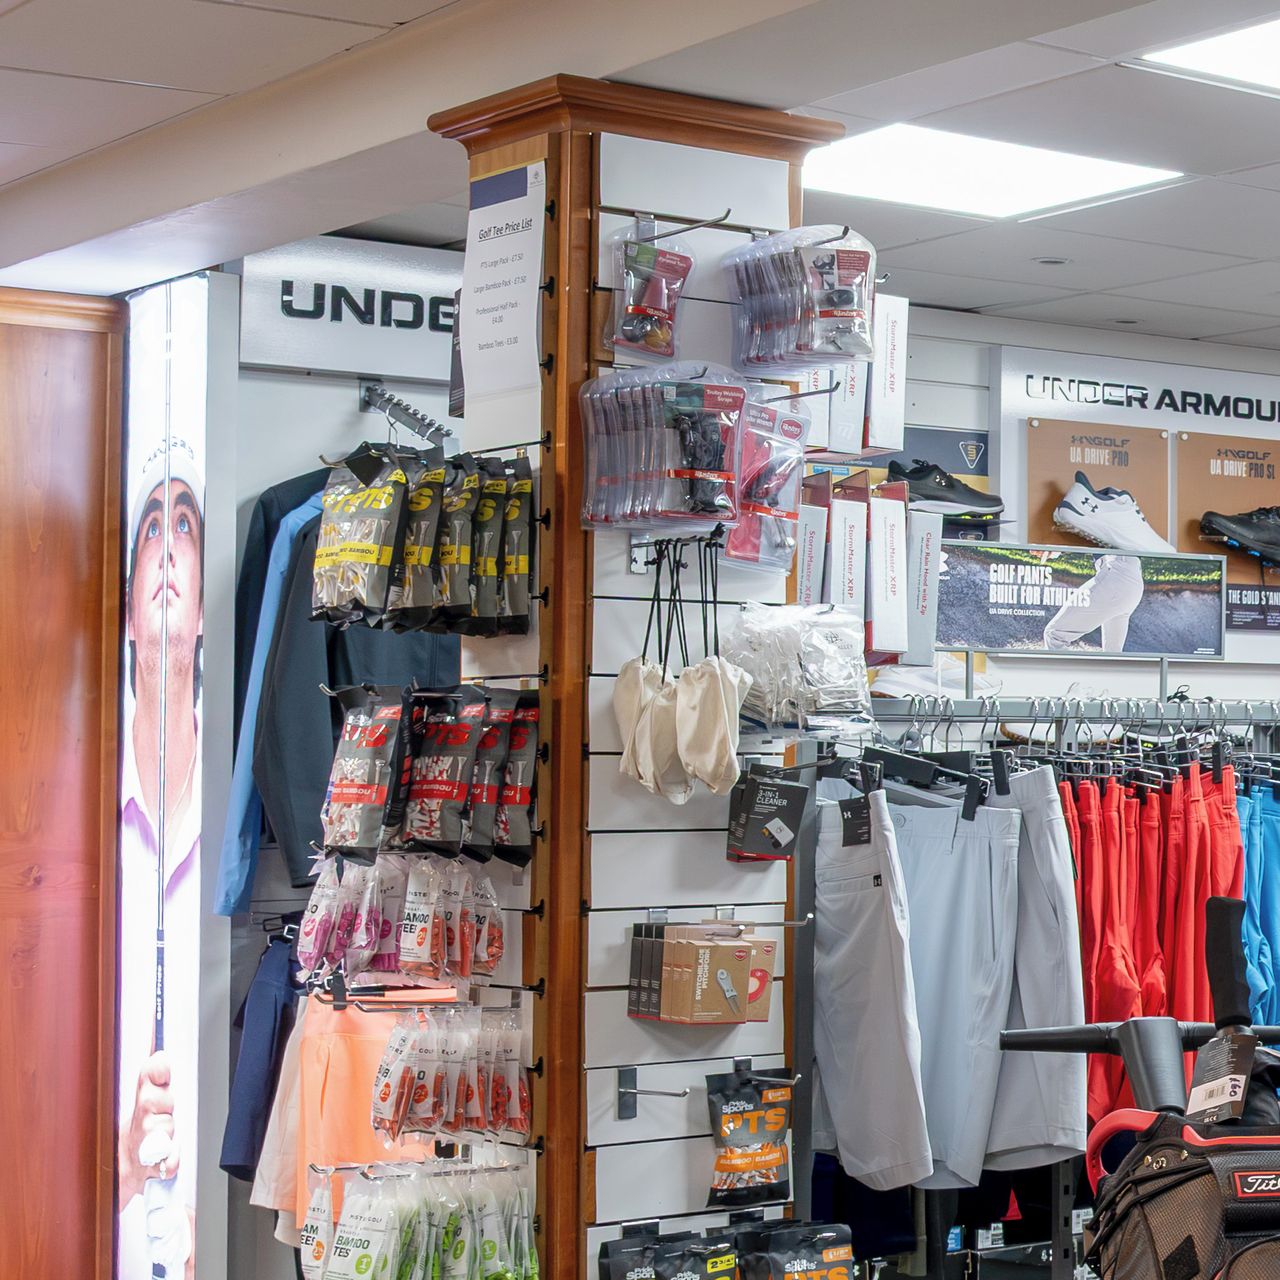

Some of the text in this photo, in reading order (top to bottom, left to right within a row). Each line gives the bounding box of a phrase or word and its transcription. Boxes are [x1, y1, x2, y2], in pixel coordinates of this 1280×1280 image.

[478, 217, 533, 240] Golf Tee Price List
[478, 342, 494, 351] Bamboo
[848, 375, 856, 396] XRP
[1026, 374, 1149, 410] UNDER
[1069, 446, 1129, 467] UA DRIVE PRO
[1210, 459, 1222, 475] UA
[1223, 460, 1247, 477] DRIVE
[1248, 462, 1264, 478] PRO
[923, 552, 931, 567] Rain
[989, 563, 1052, 585] GOLF PANTS
[989, 584, 1090, 607] BUILT FOR ATHLETES
[1228, 590, 1241, 604] THE
[1242, 590, 1260, 605] GOLD
[997, 608, 1012, 616] DRIVE
[1013, 609, 1045, 617] COLLECTION
[756, 797, 788, 806] CLEANER
[758, 790, 779, 799] 3-IN-1
[695, 948, 705, 1001] SWITCHBLADE
[702, 948, 711, 989] PITCHFORK
[722, 1103, 754, 1114] Sports
[721, 1107, 786, 1137] PTS
